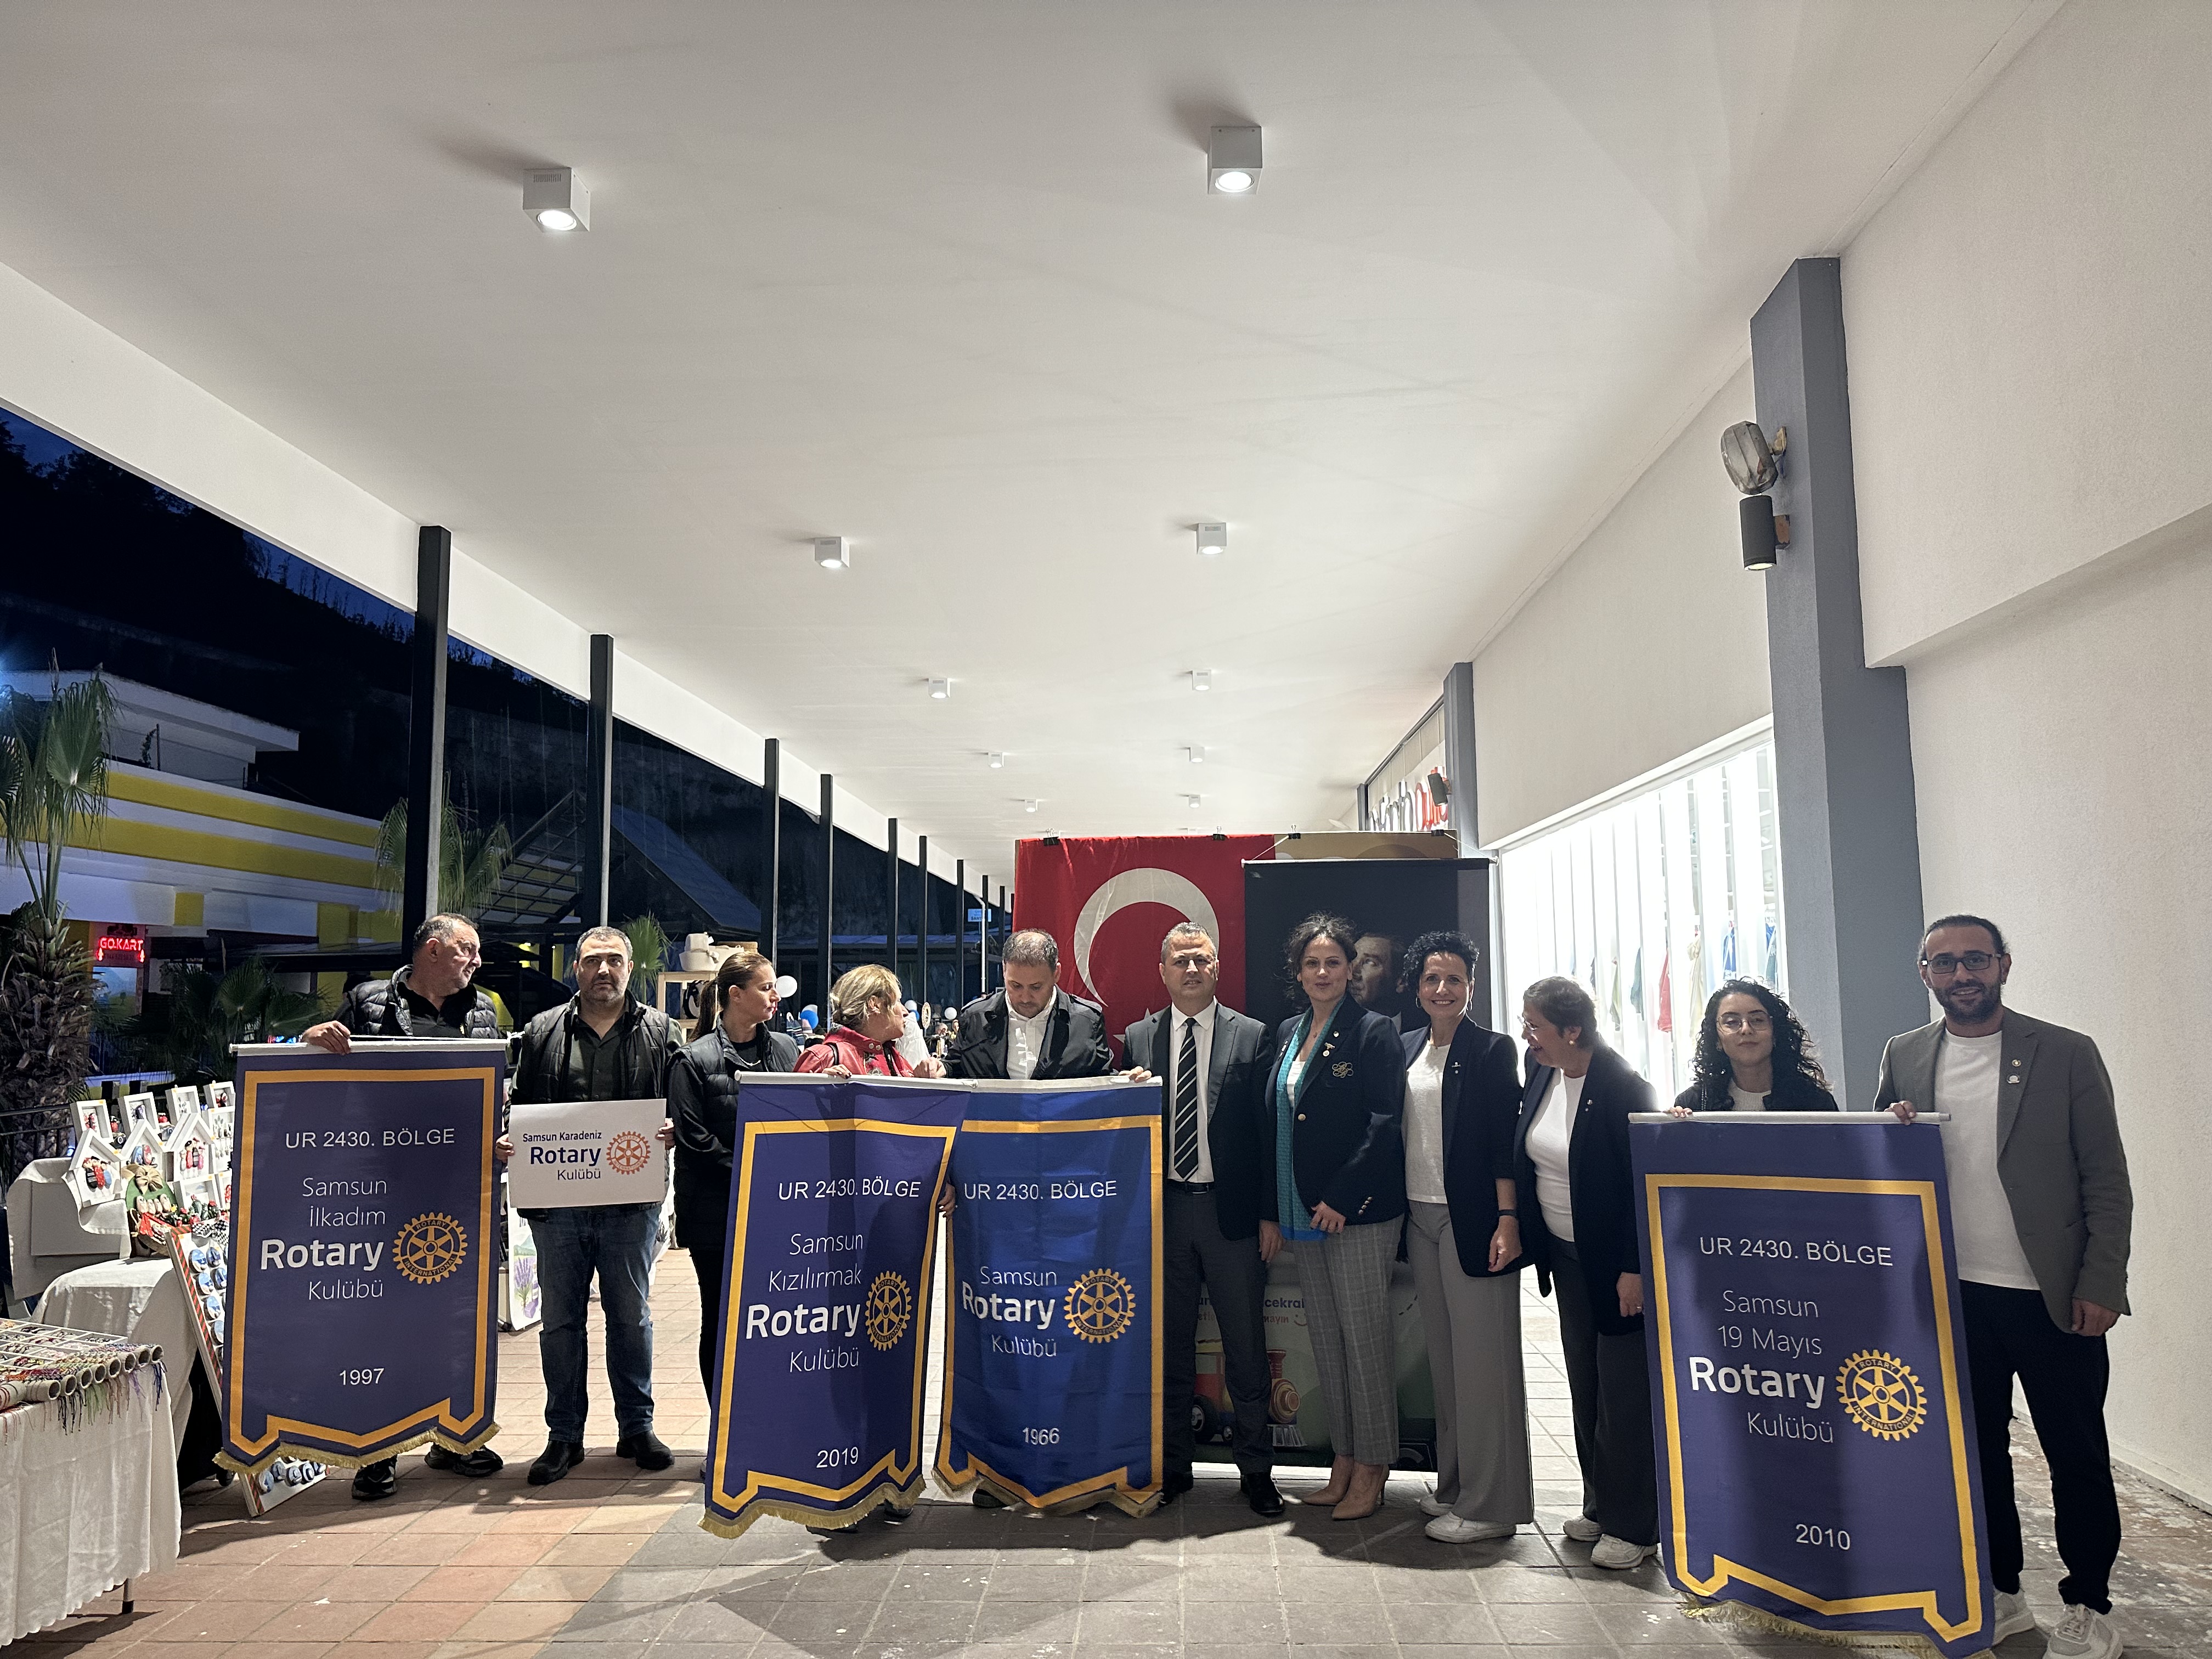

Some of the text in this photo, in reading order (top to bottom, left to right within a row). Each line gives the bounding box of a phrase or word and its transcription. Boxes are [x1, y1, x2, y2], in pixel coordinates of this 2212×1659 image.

[286, 1128, 455, 1148] UR 2430. BÖLGE
[523, 1130, 602, 1142] Samsun Karadeniz
[531, 1147, 601, 1166] Rotary
[557, 1168, 601, 1180] Kulübü
[302, 1177, 387, 1197] Samsun
[778, 1176, 921, 1200] UR 2430. BÖLGE
[964, 1180, 1117, 1200] UR 2430. BÖLGE
[309, 1205, 385, 1227] İlkadım
[416, 1220, 447, 1230] ROTARY
[789, 1233, 864, 1255] Samsun
[1700, 1237, 1893, 1266] UR 2430. BÖLGE
[261, 1239, 383, 1271] Rotary
[405, 1256, 456, 1276] INTERNATIONAL
[980, 1266, 1057, 1286] Samsun
[769, 1263, 861, 1292] Kızılırmak
[878, 1280, 898, 1289] ROTARY
[1085, 1276, 1115, 1286] ROTARY
[309, 1279, 383, 1300] Kulübü
[962, 1281, 1056, 1330] Rotary
[1723, 1289, 1819, 1318] Samsun
[746, 1304, 860, 1339] Rotary
[871, 1322, 902, 1342] INTERNATIONAL
[991, 1334, 1057, 1358] Kulübü
[1718, 1325, 1822, 1359] 19 Mayıs
[790, 1346, 859, 1373] Kulübü
[1859, 1359, 1897, 1371] ROTARY
[340, 1368, 384, 1385] 1997
[1689, 1356, 1825, 1409] Rotary
[1748, 1412, 1834, 1443] Kulübü
[1854, 1405, 1915, 1430] INTERNATIONAL
[1022, 1427, 1060, 1445] 1966
[816, 1447, 859, 1468] 2019
[1796, 1523, 1850, 1550] 2010
